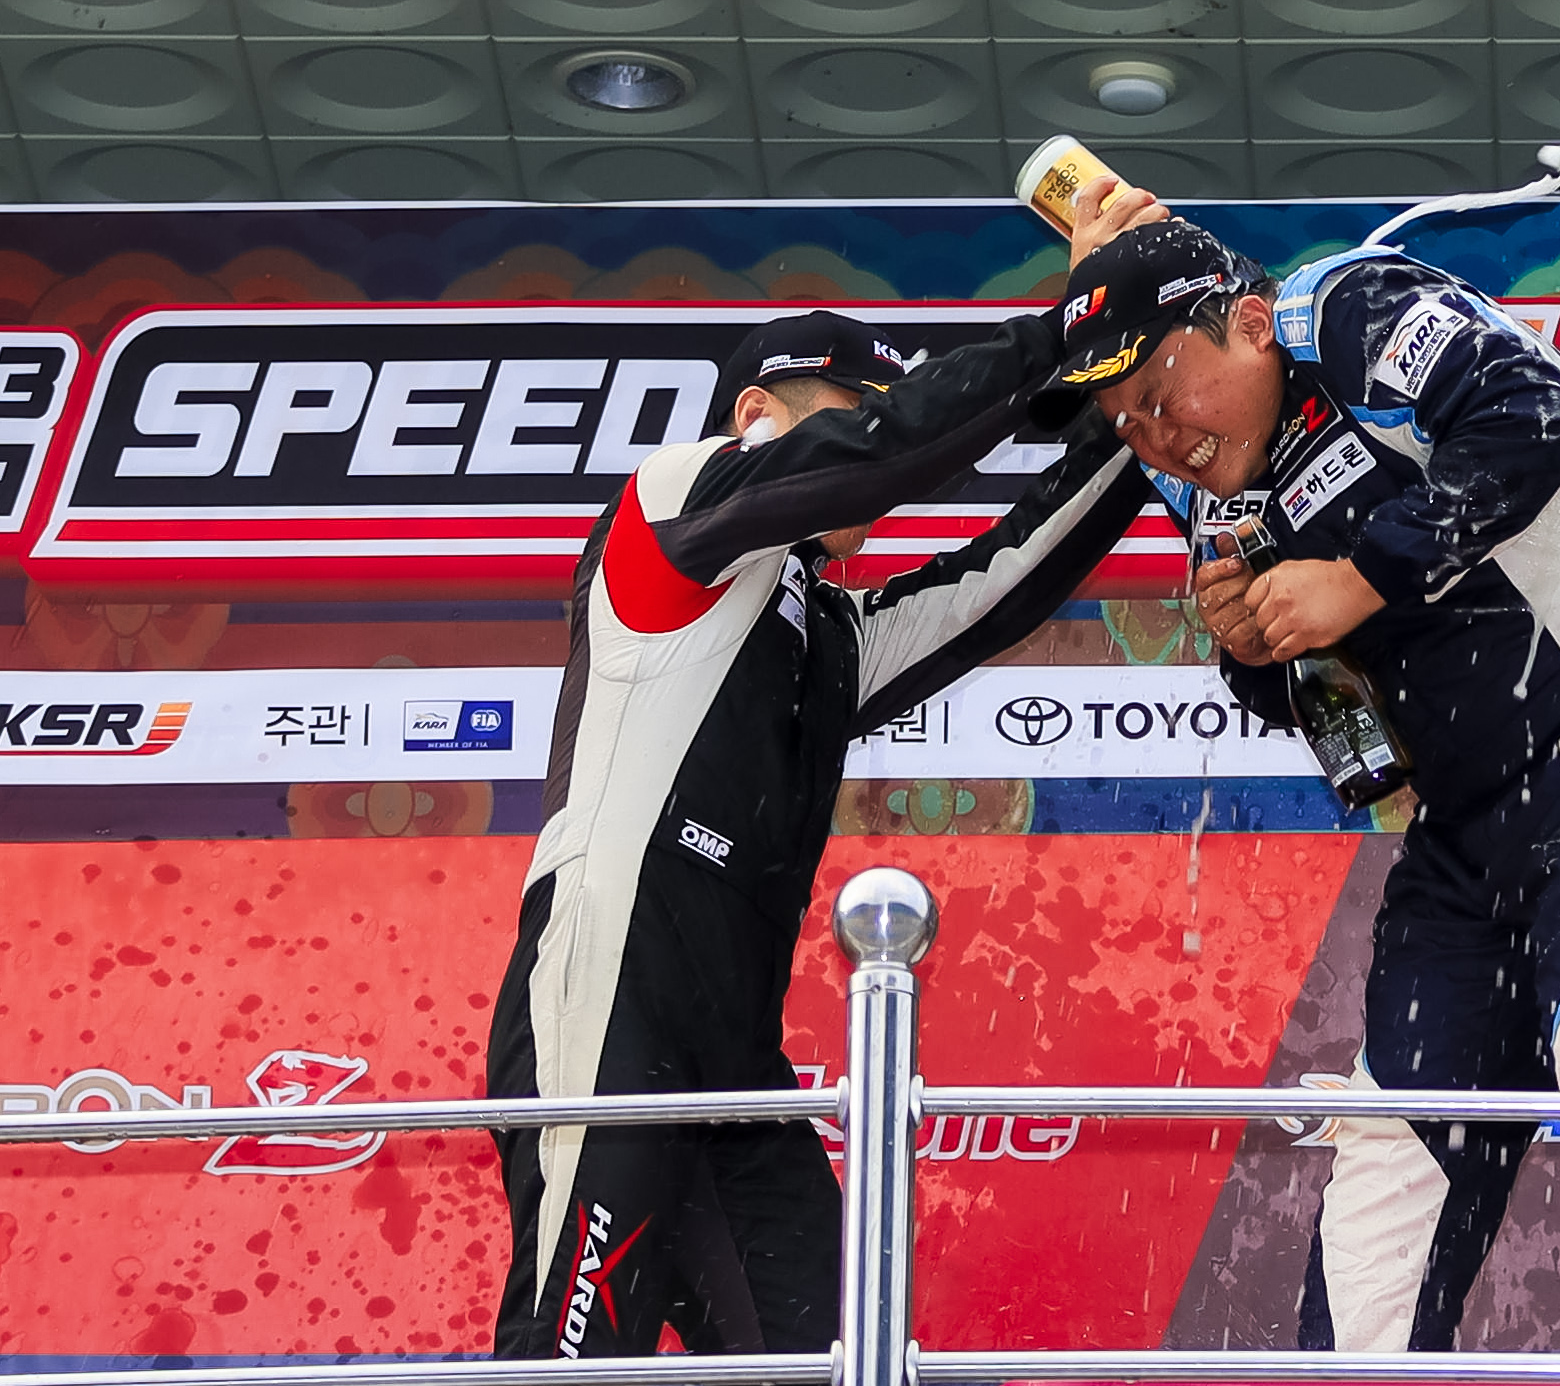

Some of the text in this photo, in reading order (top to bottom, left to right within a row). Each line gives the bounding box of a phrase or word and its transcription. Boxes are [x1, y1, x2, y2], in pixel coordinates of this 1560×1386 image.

[1043, 163, 1077, 202] COPAS
[1057, 175, 1080, 201] DOS
[1398, 314, 1442, 378] KARA
[115, 358, 720, 477] SPEED
[1305, 441, 1367, 494] 하드론
[264, 704, 351, 747] 주관
[412, 720, 448, 730] KARA
[472, 713, 498, 728] FIA
[862, 702, 928, 744] 원
[681, 825, 730, 858] OMP
